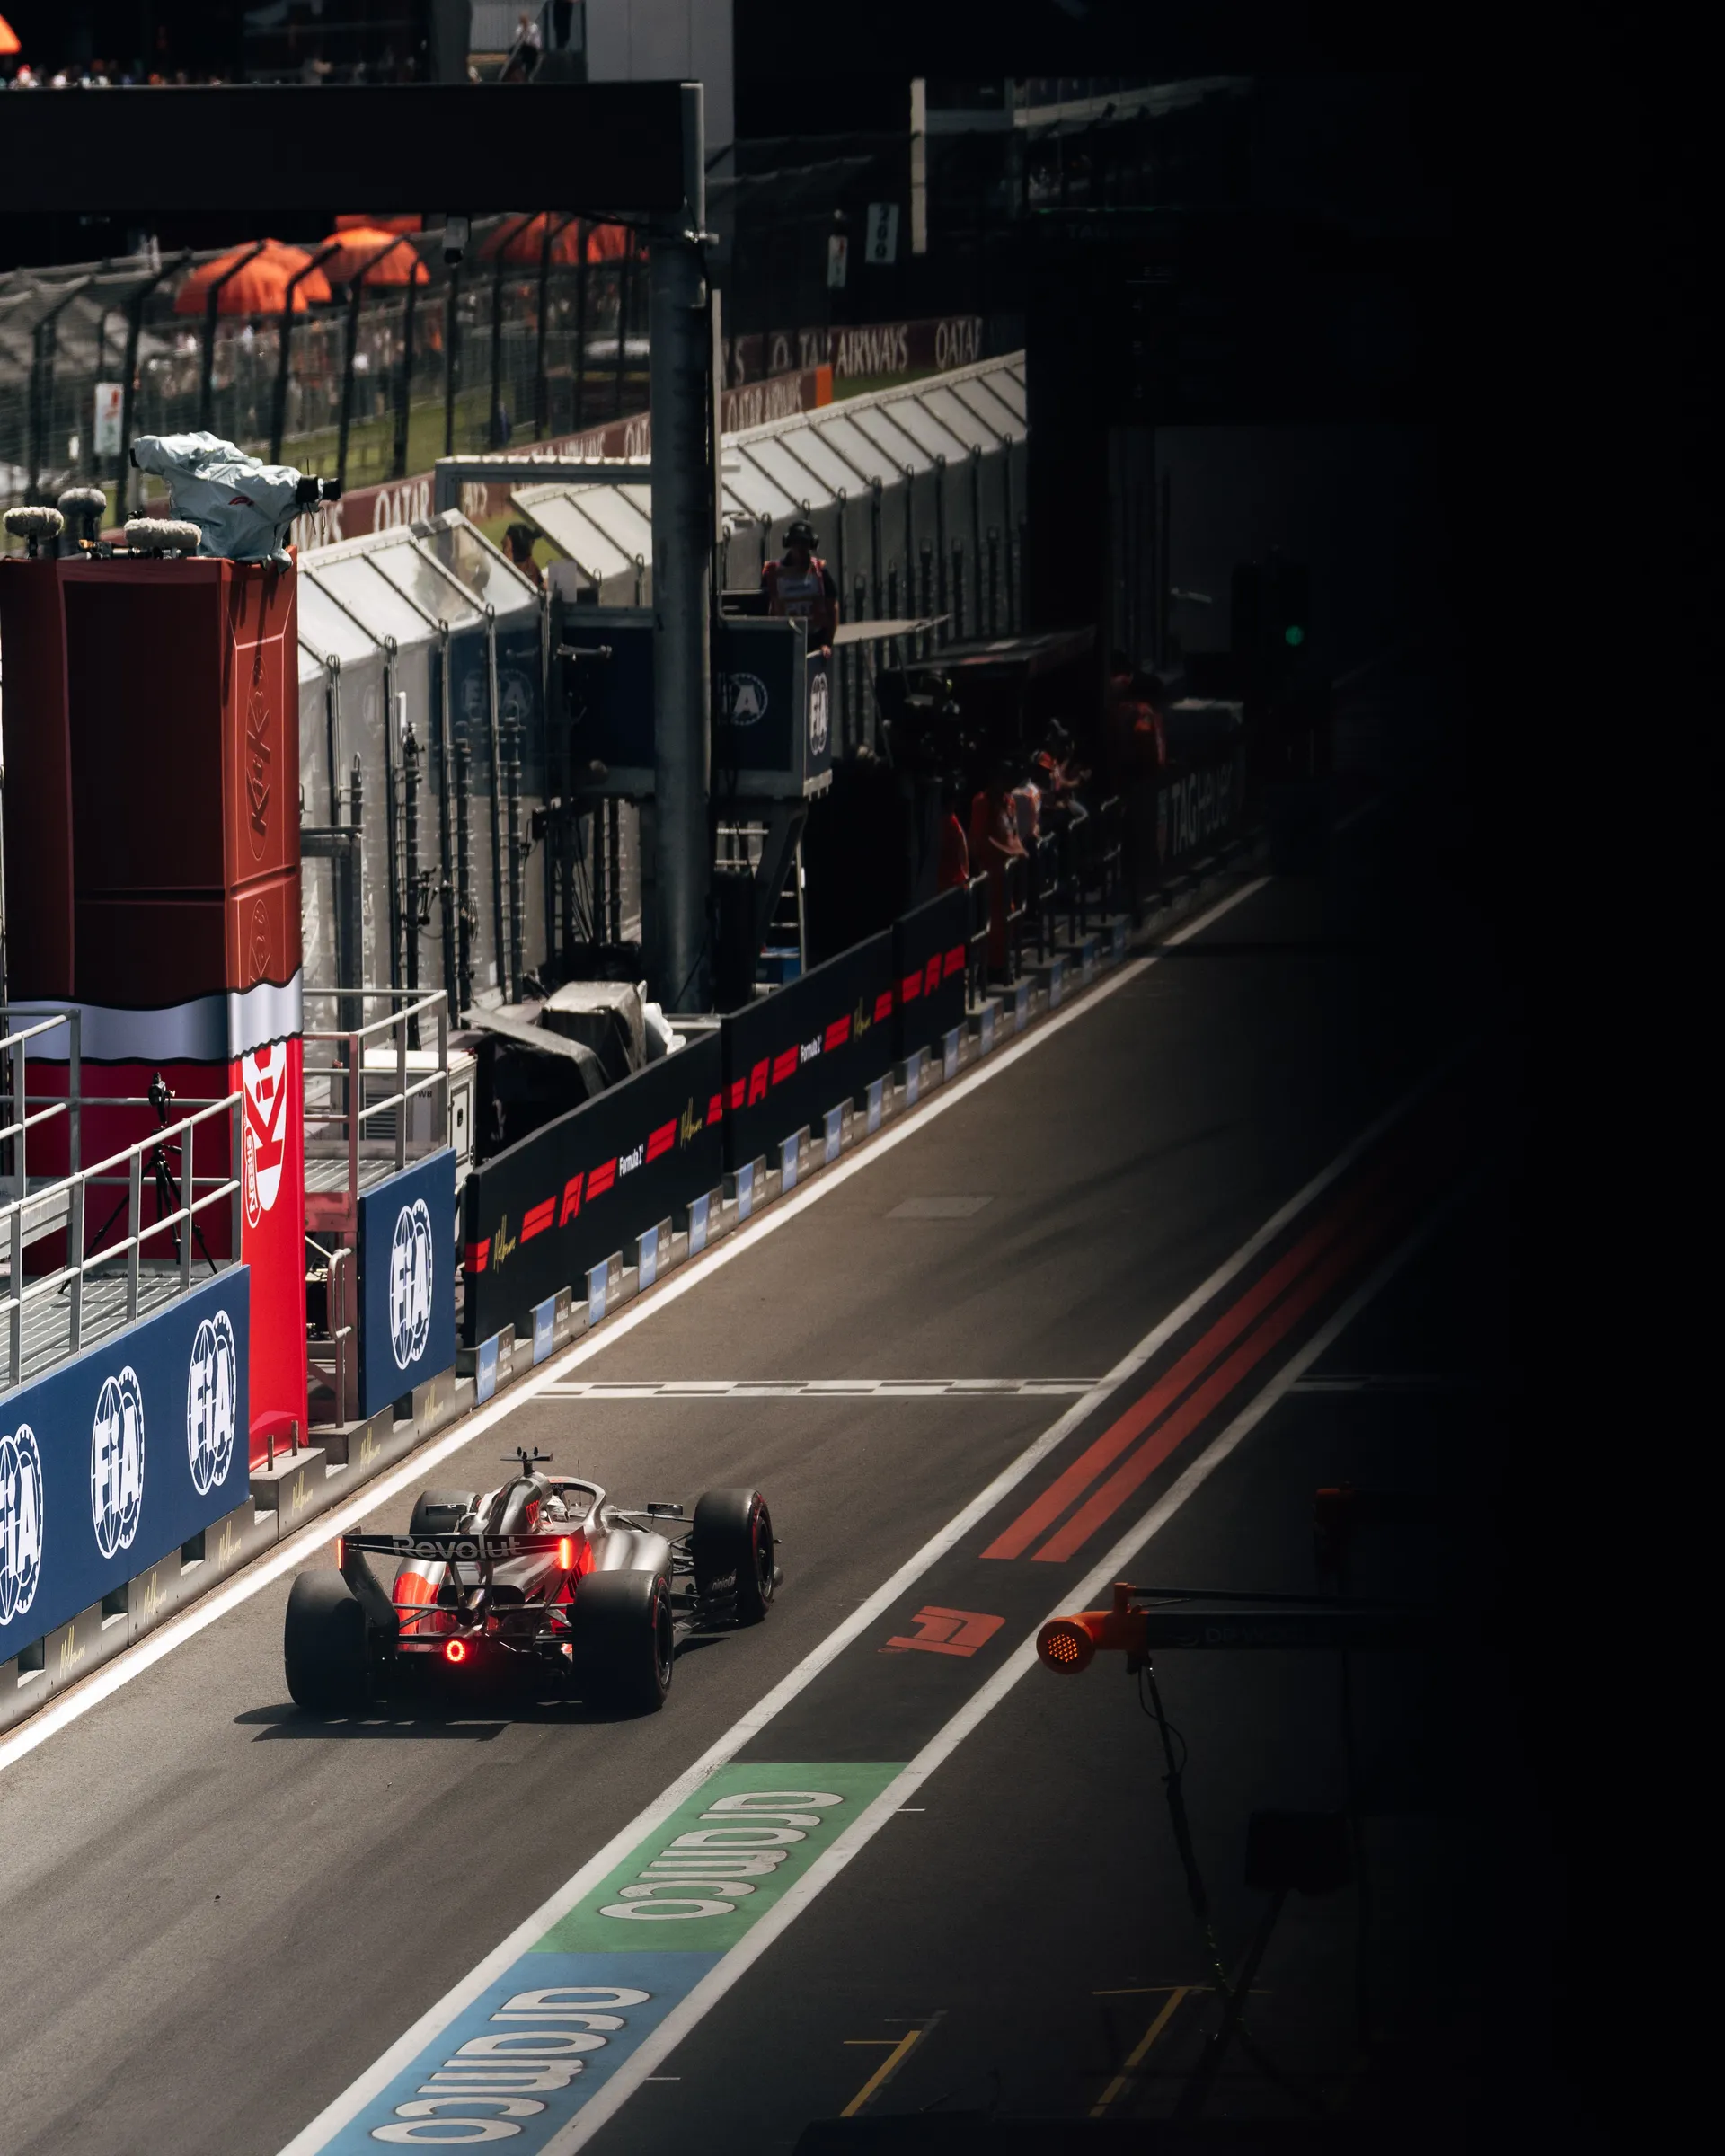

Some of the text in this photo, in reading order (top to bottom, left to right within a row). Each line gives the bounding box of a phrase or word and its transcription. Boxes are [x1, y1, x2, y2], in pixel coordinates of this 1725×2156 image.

[392, 1534, 523, 1560] Revolut
[597, 1790, 845, 1921] aramco
[370, 1986, 651, 2145] aramco
